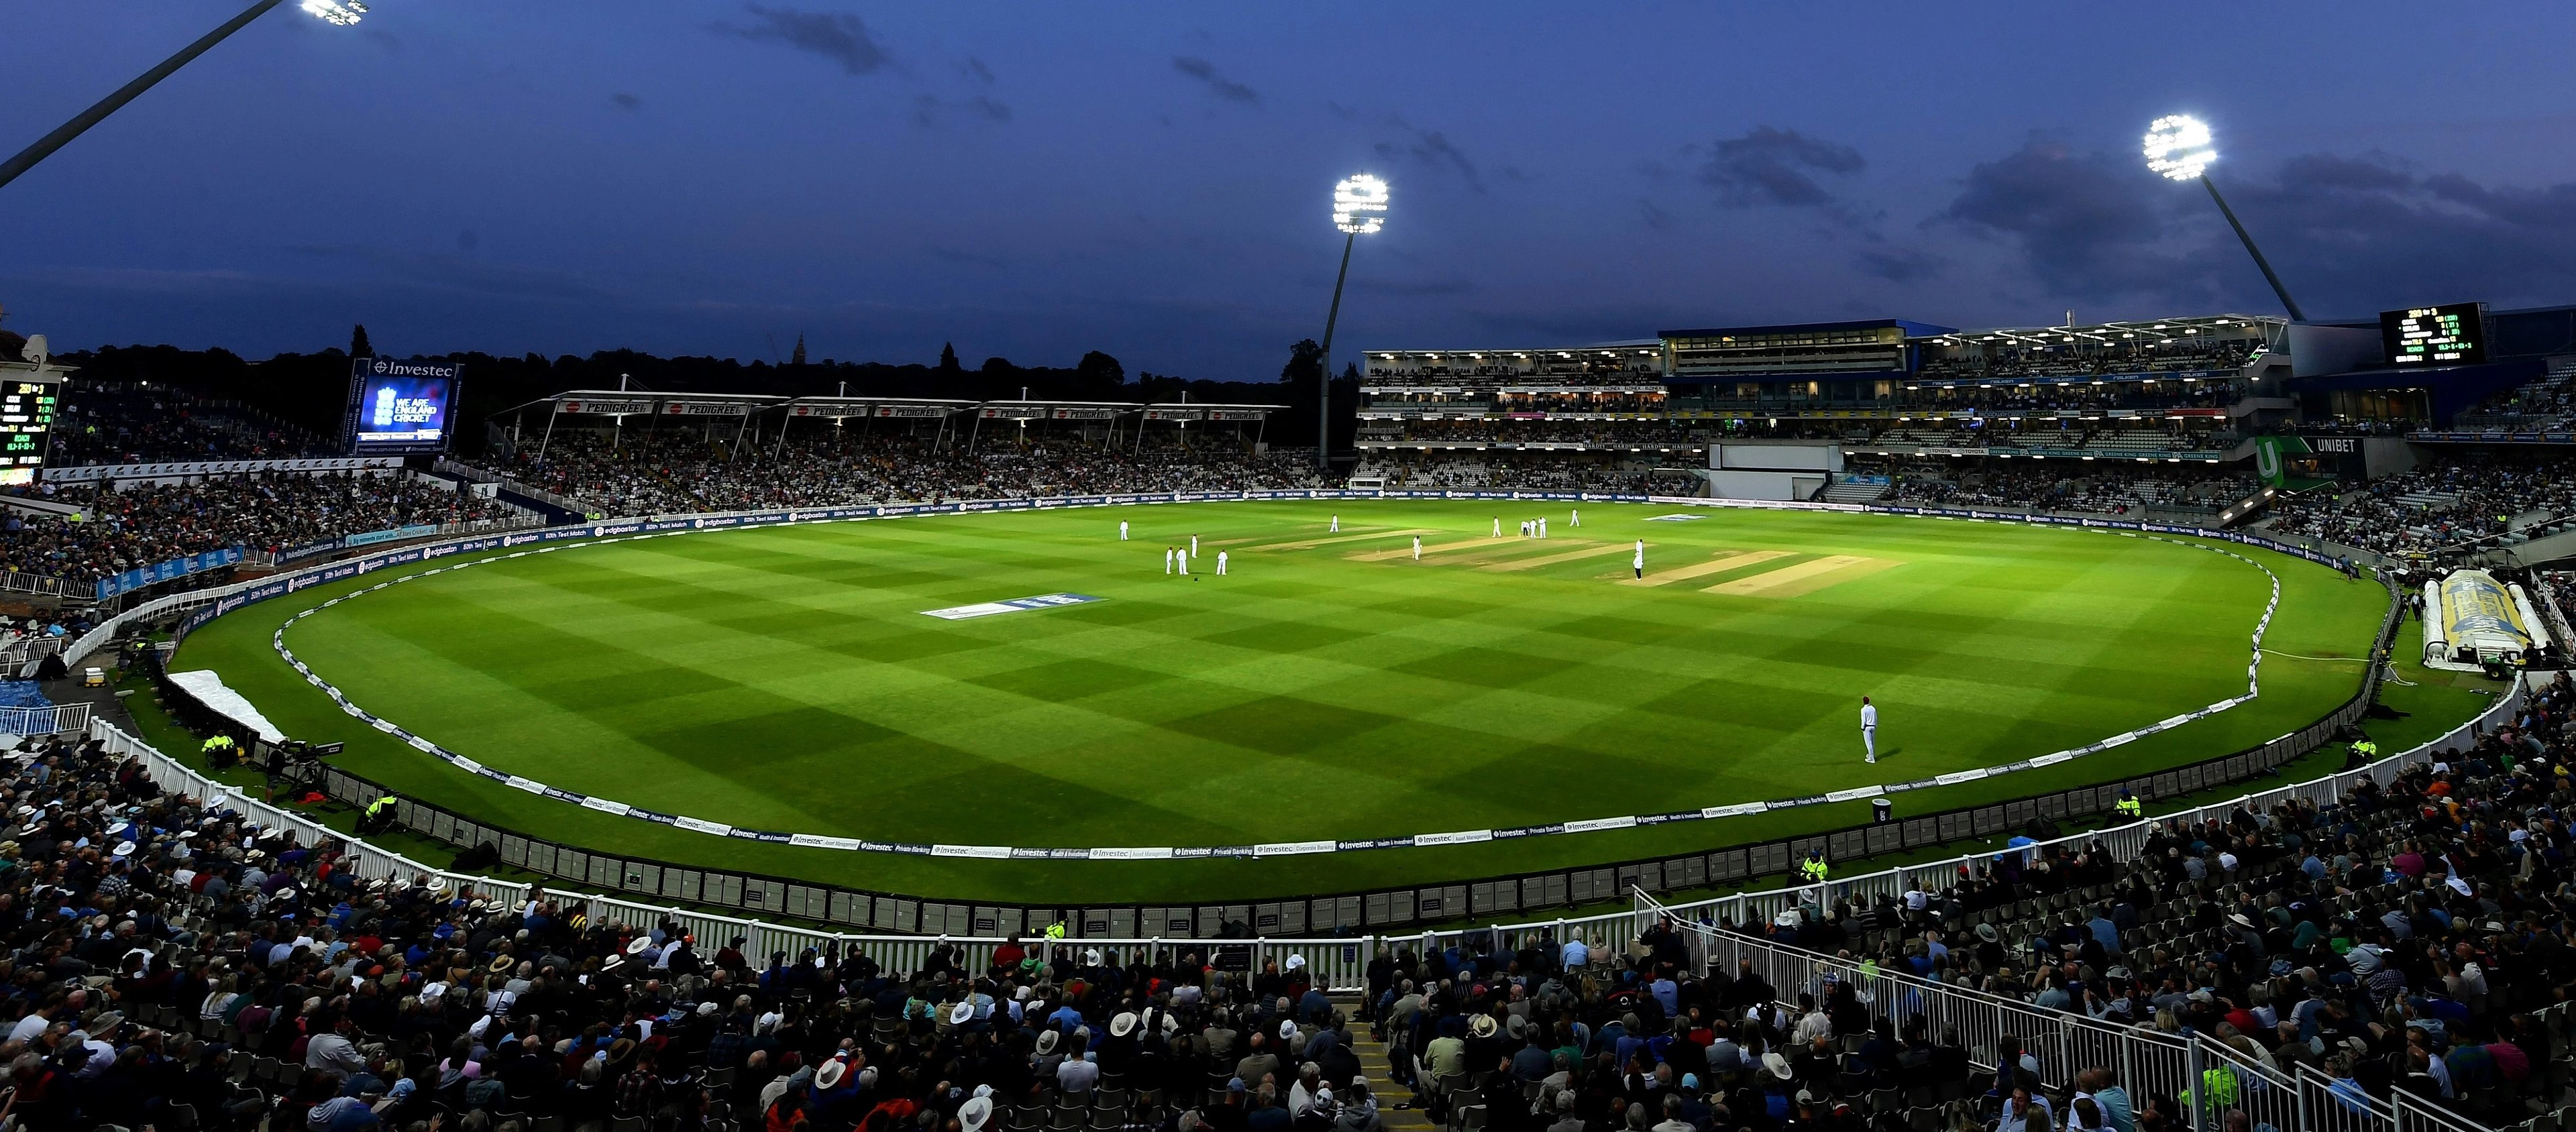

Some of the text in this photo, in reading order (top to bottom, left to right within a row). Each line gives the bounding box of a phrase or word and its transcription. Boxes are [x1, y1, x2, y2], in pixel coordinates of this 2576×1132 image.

[389, 362, 452, 376] Investec
[396, 398, 429, 407] WE ARE
[586, 403, 640, 412] PEDIGREE
[687, 405, 735, 414] PEDIGREE
[394, 414, 431, 422] CRICKET
[2318, 439, 2354, 452] UNIBET
[2257, 441, 2277, 478] U
[798, 511, 827, 520] edgbaston
[705, 517, 736, 526] edgbaston
[605, 525, 638, 534] edgbaston
[511, 534, 538, 545] edgbaston
[431, 546, 457, 557] edgbaston
[365, 559, 384, 571] edgbaston
[343, 567, 354, 576] Match
[294, 575, 319, 589] edgbaston
[261, 585, 283, 597] Test Match
[222, 596, 245, 611] edgbaston
[1890, 783, 1910, 791] Investec
[1834, 792, 1855, 800] Investec
[1772, 800, 1795, 808] Investec
[632, 809, 649, 819] Investec
[682, 819, 700, 829] Investec
[1572, 822, 1598, 830] Investec
[1620, 818, 1634, 826] Banking
[1642, 815, 1668, 824] Investec
[735, 830, 758, 839] Investec
[1499, 829, 1526, 837] Investec
[1546, 825, 1564, 833] Banking
[798, 836, 823, 845] Investec
[1424, 835, 1451, 843] Investec
[866, 843, 893, 851] Investec
[1345, 840, 1374, 849] Investec
[940, 847, 968, 855] Investec
[1019, 848, 1048, 857] Investec
[1181, 848, 1212, 856] Investec
